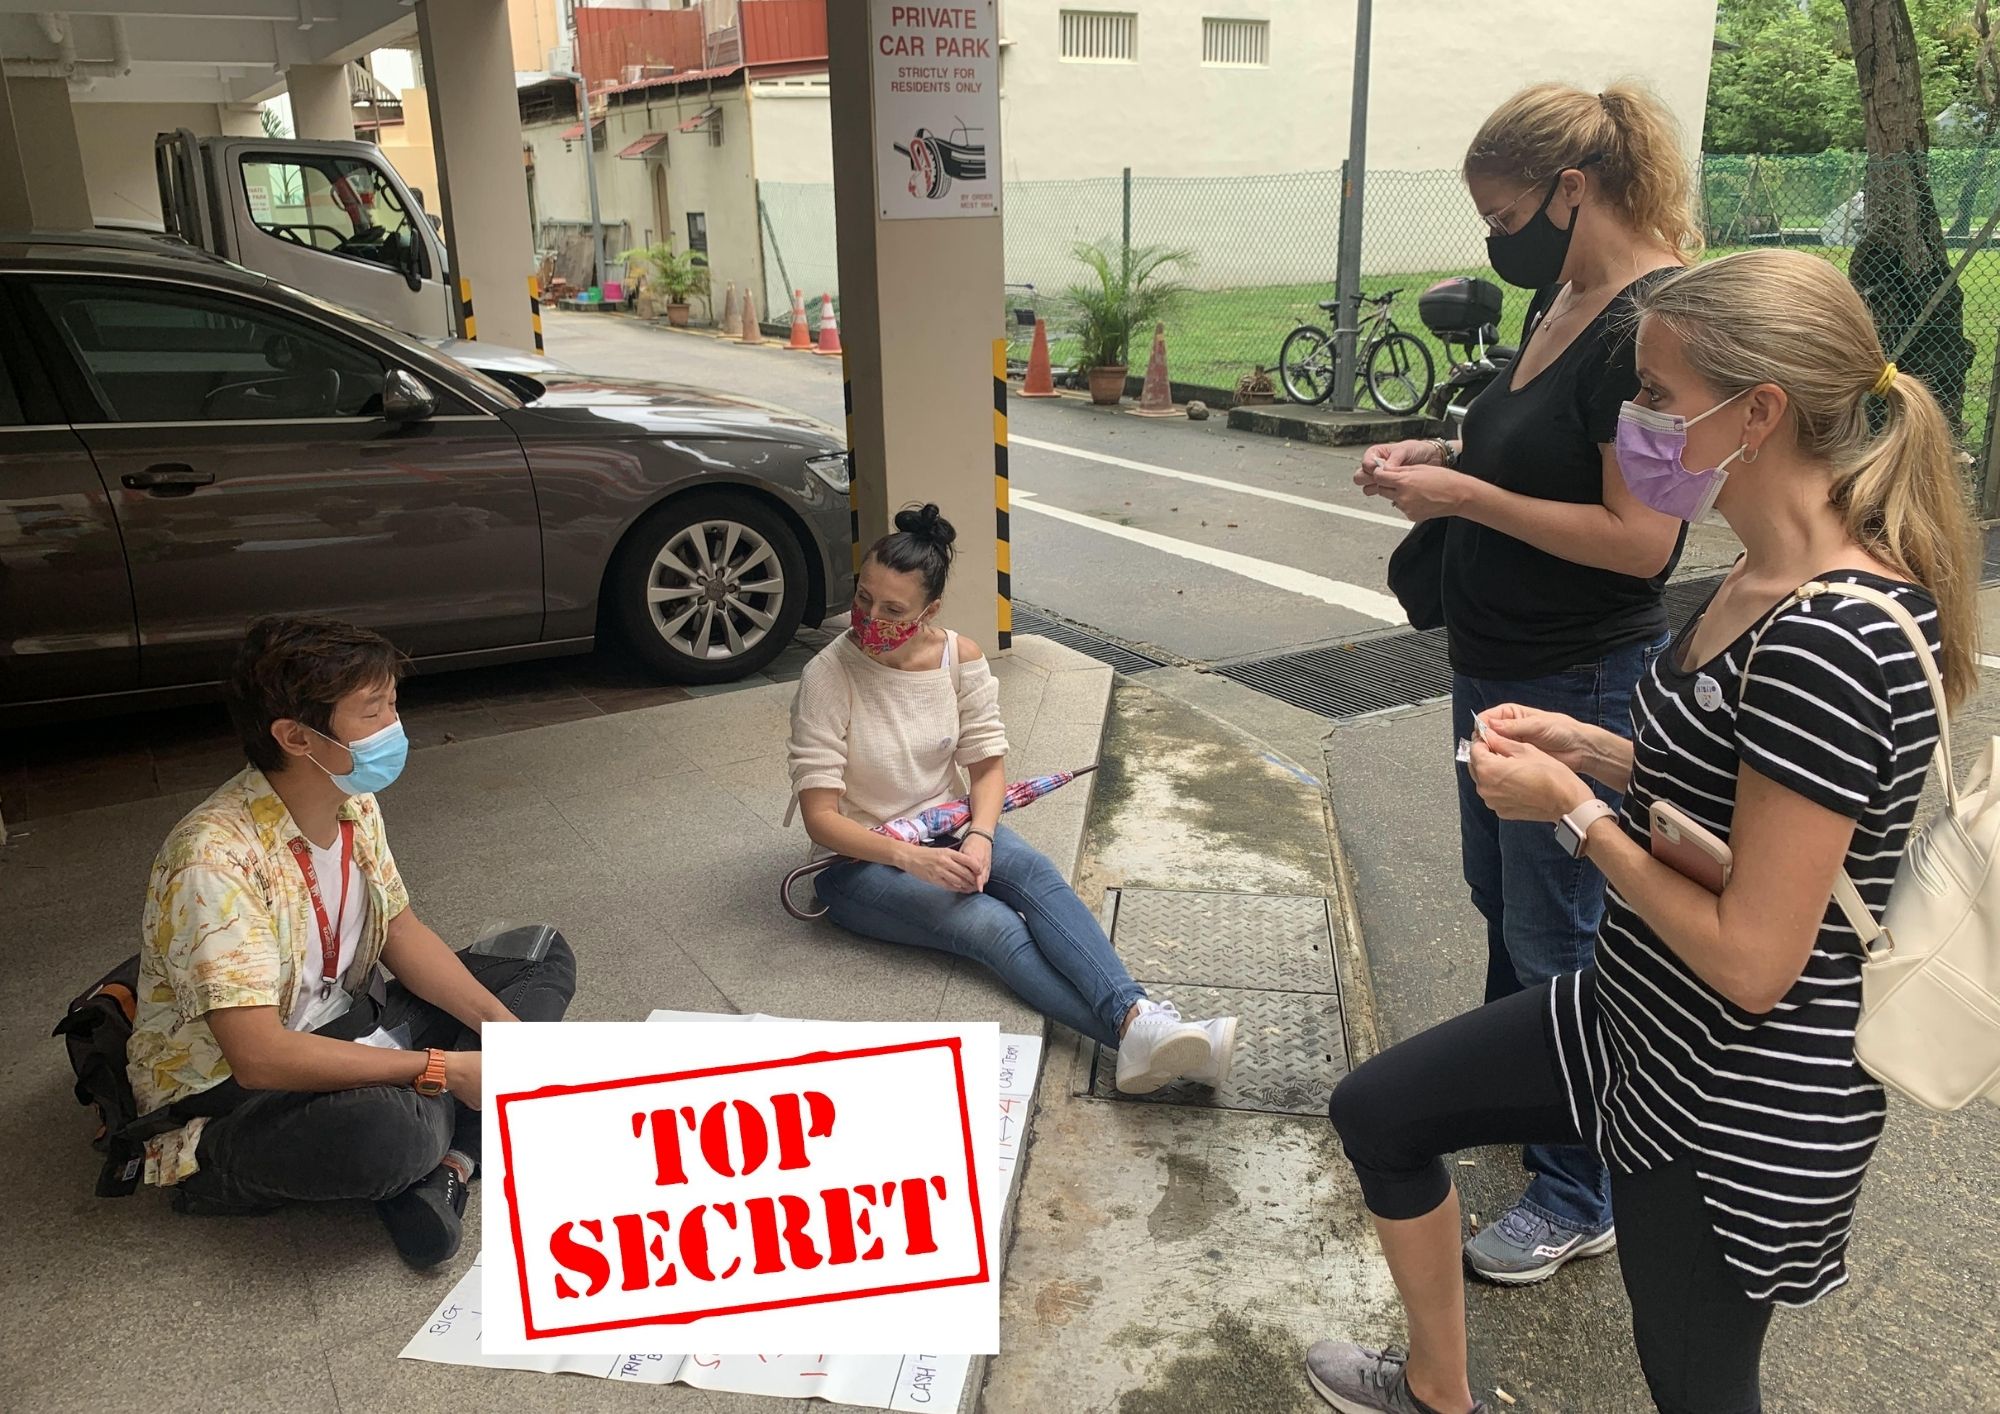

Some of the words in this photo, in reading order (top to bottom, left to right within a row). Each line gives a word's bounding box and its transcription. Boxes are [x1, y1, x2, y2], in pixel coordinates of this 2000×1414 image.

[892, 6, 977, 29] PRIVATE
[879, 35, 925, 57] CAR
[936, 37, 990, 58] PARK
[898, 67, 948, 79] STRICTLY
[954, 68, 975, 79] FOR
[891, 81, 951, 93] RESIDENTS
[955, 82, 983, 94] ONLY
[429, 1303, 463, 1336] BIG
[620, 1354, 646, 1377] TRIP
[910, 1366, 937, 1403] CASH
